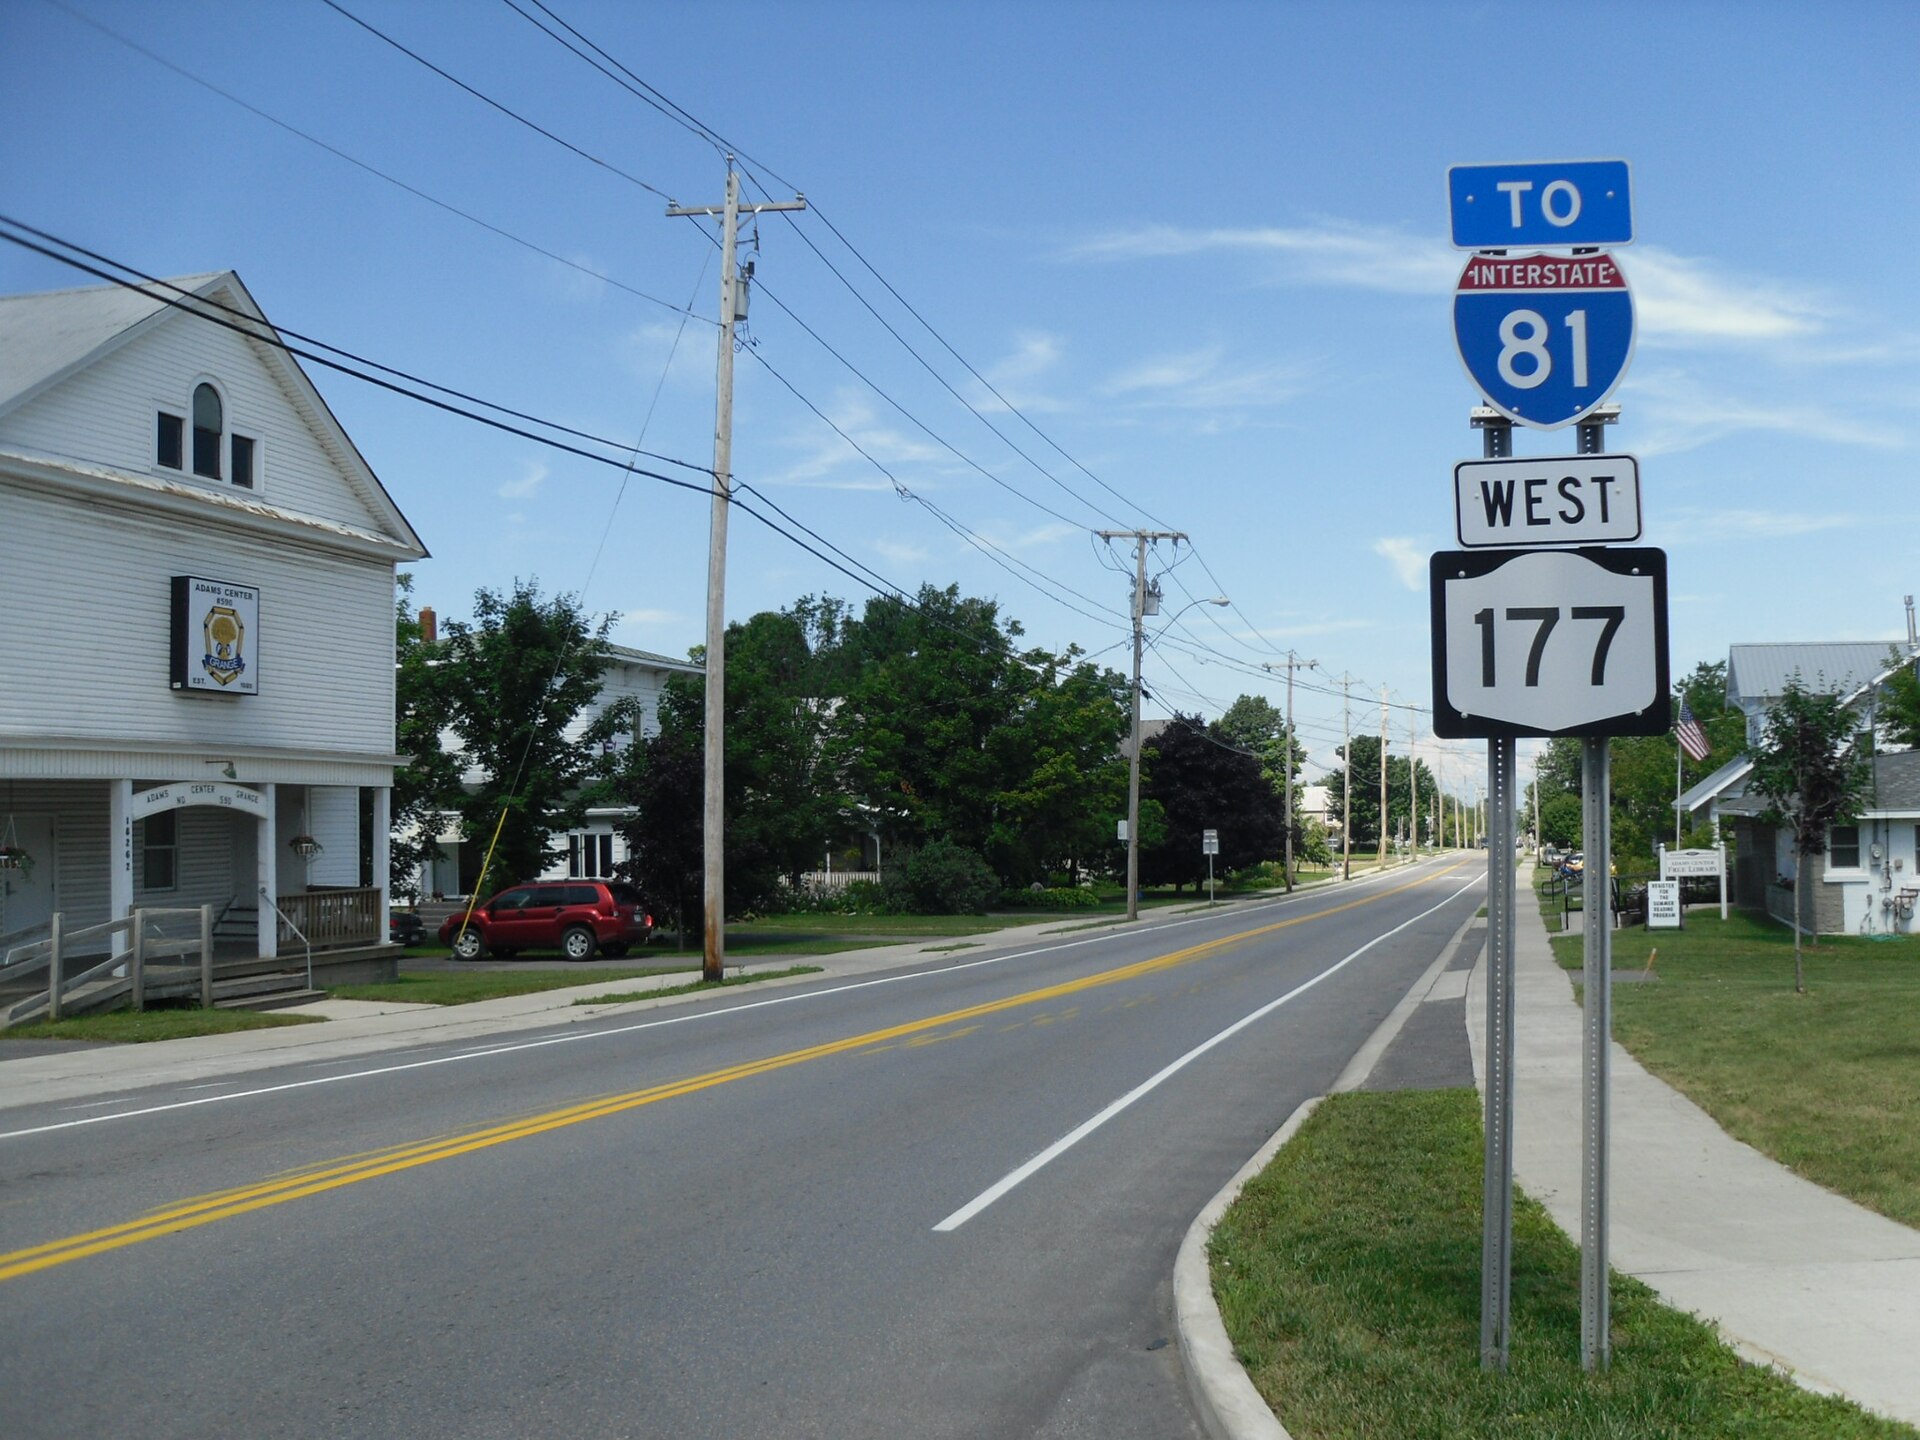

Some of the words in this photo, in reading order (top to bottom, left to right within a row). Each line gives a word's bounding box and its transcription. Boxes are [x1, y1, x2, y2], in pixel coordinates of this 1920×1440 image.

[1497, 180, 1581, 228] TO
[1473, 263, 1611, 285] INTERSTATE
[1497, 309, 1588, 389] 81
[1480, 476, 1615, 527] WEST
[195, 583, 221, 595] ADAMS
[224, 588, 254, 600] CENTER
[1474, 606, 1625, 688] 177
[209, 658, 238, 670] GRANGE
[146, 789, 169, 803] ADAMS
[191, 784, 215, 794] CENTER
[235, 790, 259, 804] GRANGE
[219, 795, 232, 805] 590
